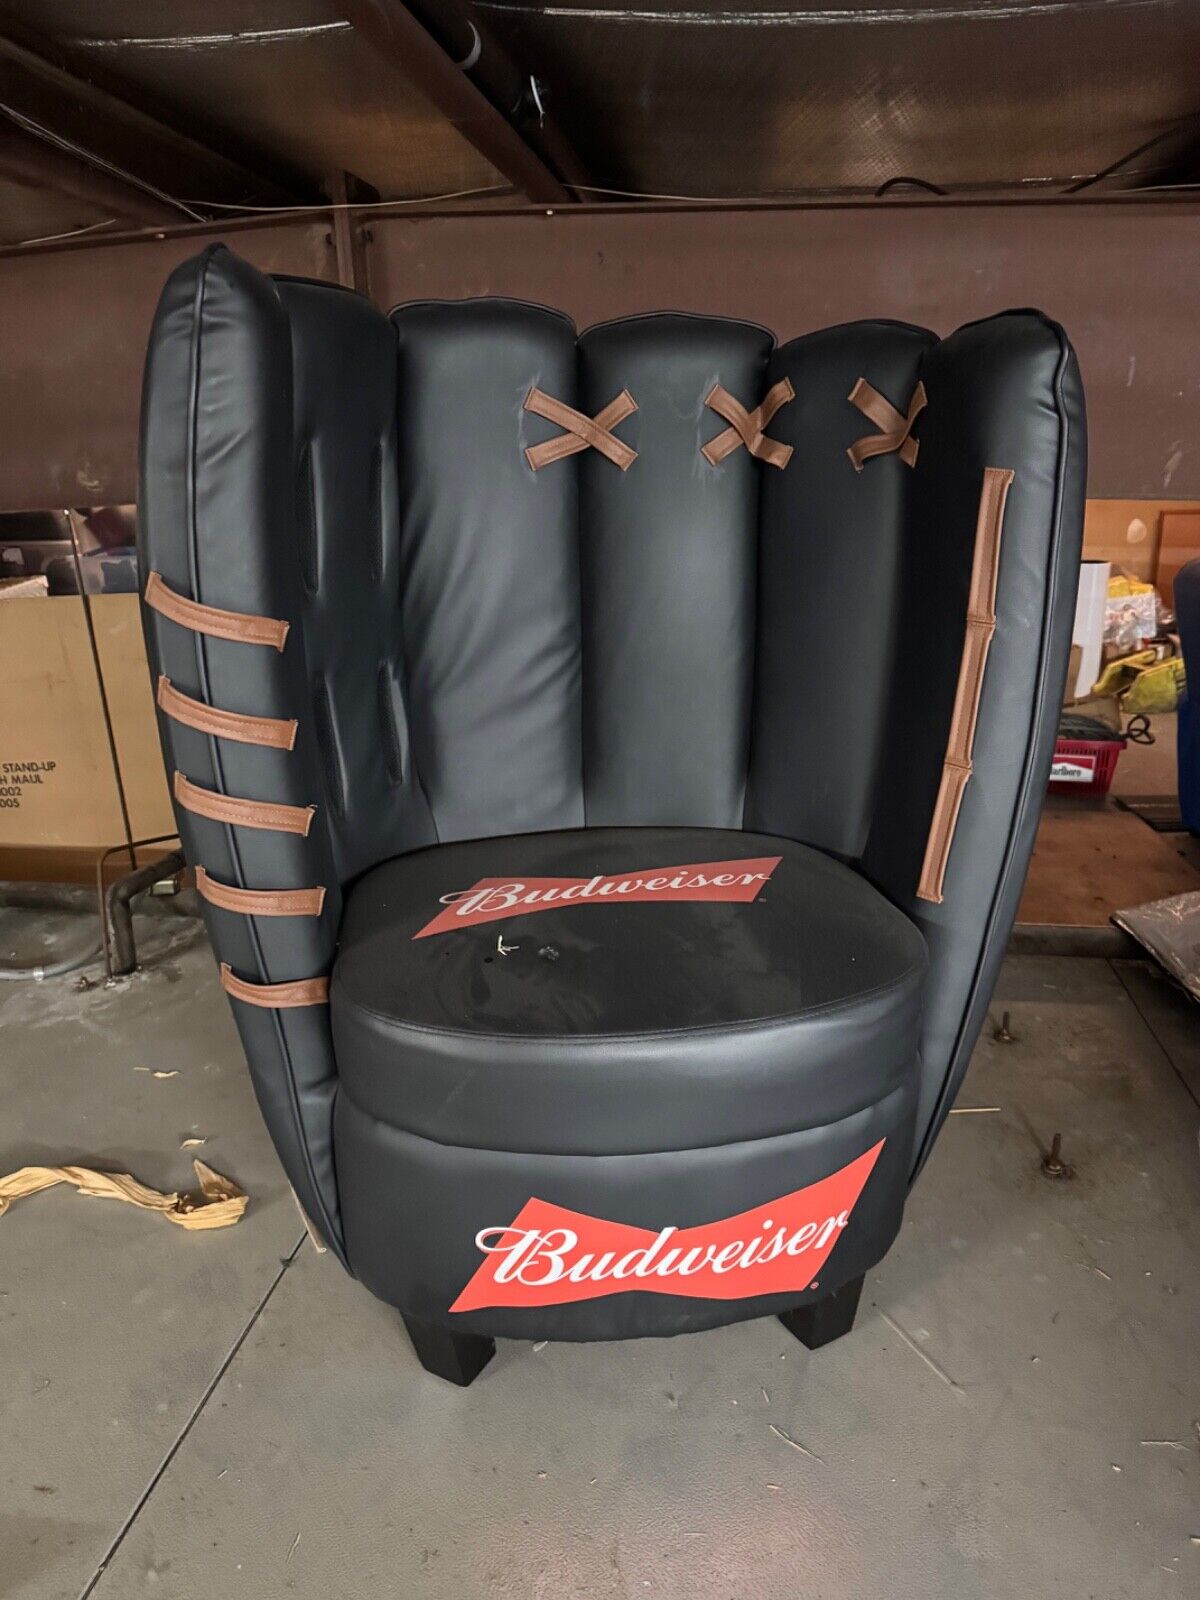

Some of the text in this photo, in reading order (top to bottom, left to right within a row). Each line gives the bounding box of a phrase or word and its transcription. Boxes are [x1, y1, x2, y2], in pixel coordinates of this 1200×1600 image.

[2, 761, 56, 773] STAND-UP
[1051, 765, 1082, 777] arlboro
[11, 774, 44, 784] MAUL
[0, 786, 22, 797] 002
[438, 870, 772, 916] Budweiser
[474, 1209, 849, 1287] Budweiser
